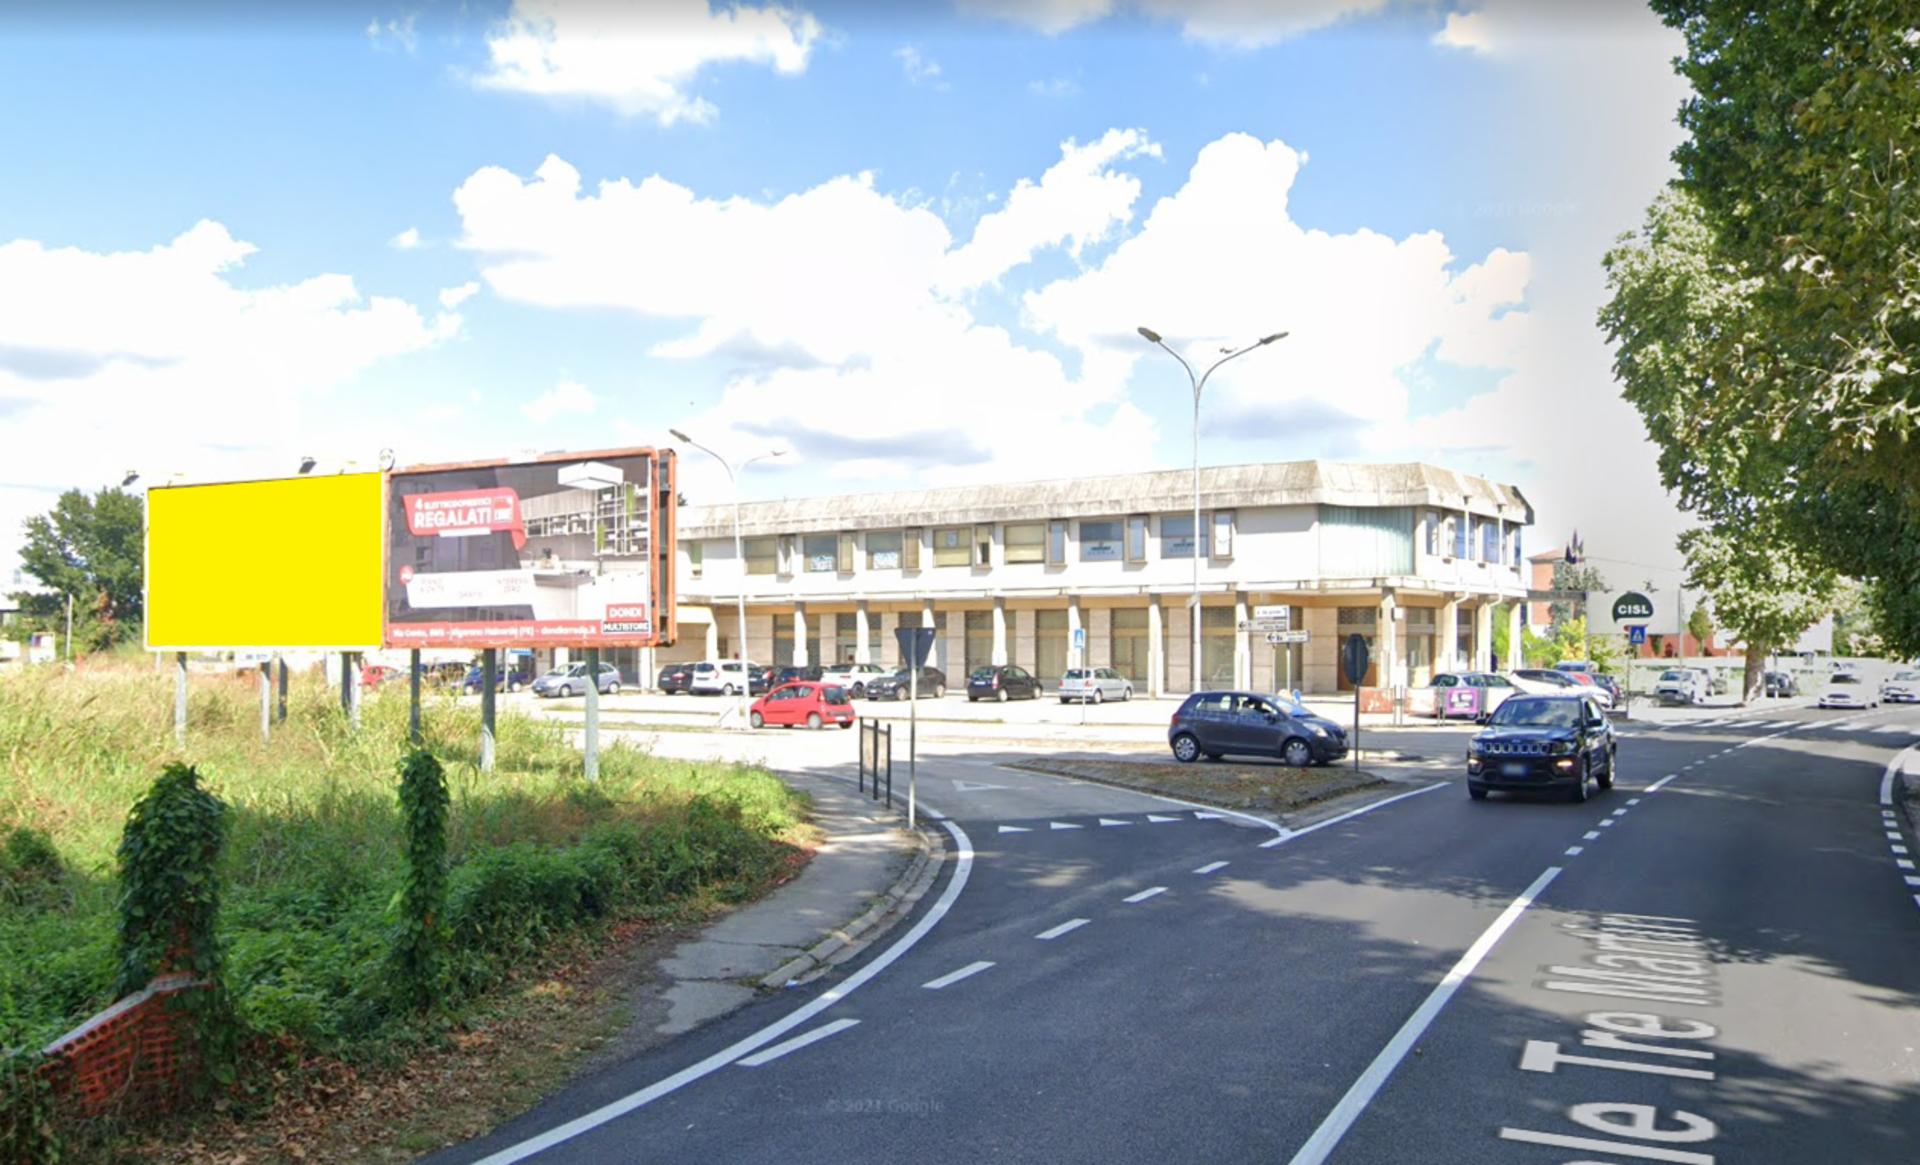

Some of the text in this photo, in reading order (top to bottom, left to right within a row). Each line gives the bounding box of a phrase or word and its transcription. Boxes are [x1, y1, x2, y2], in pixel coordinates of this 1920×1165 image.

[415, 498, 423, 510] 4
[414, 508, 492, 528] REGALATI
[609, 608, 642, 618] DONDI
[1617, 604, 1649, 615] CISL
[604, 623, 648, 632] MULTISTORE
[1520, 1012, 1718, 1080] Tre
[1500, 1103, 1717, 1165] le
